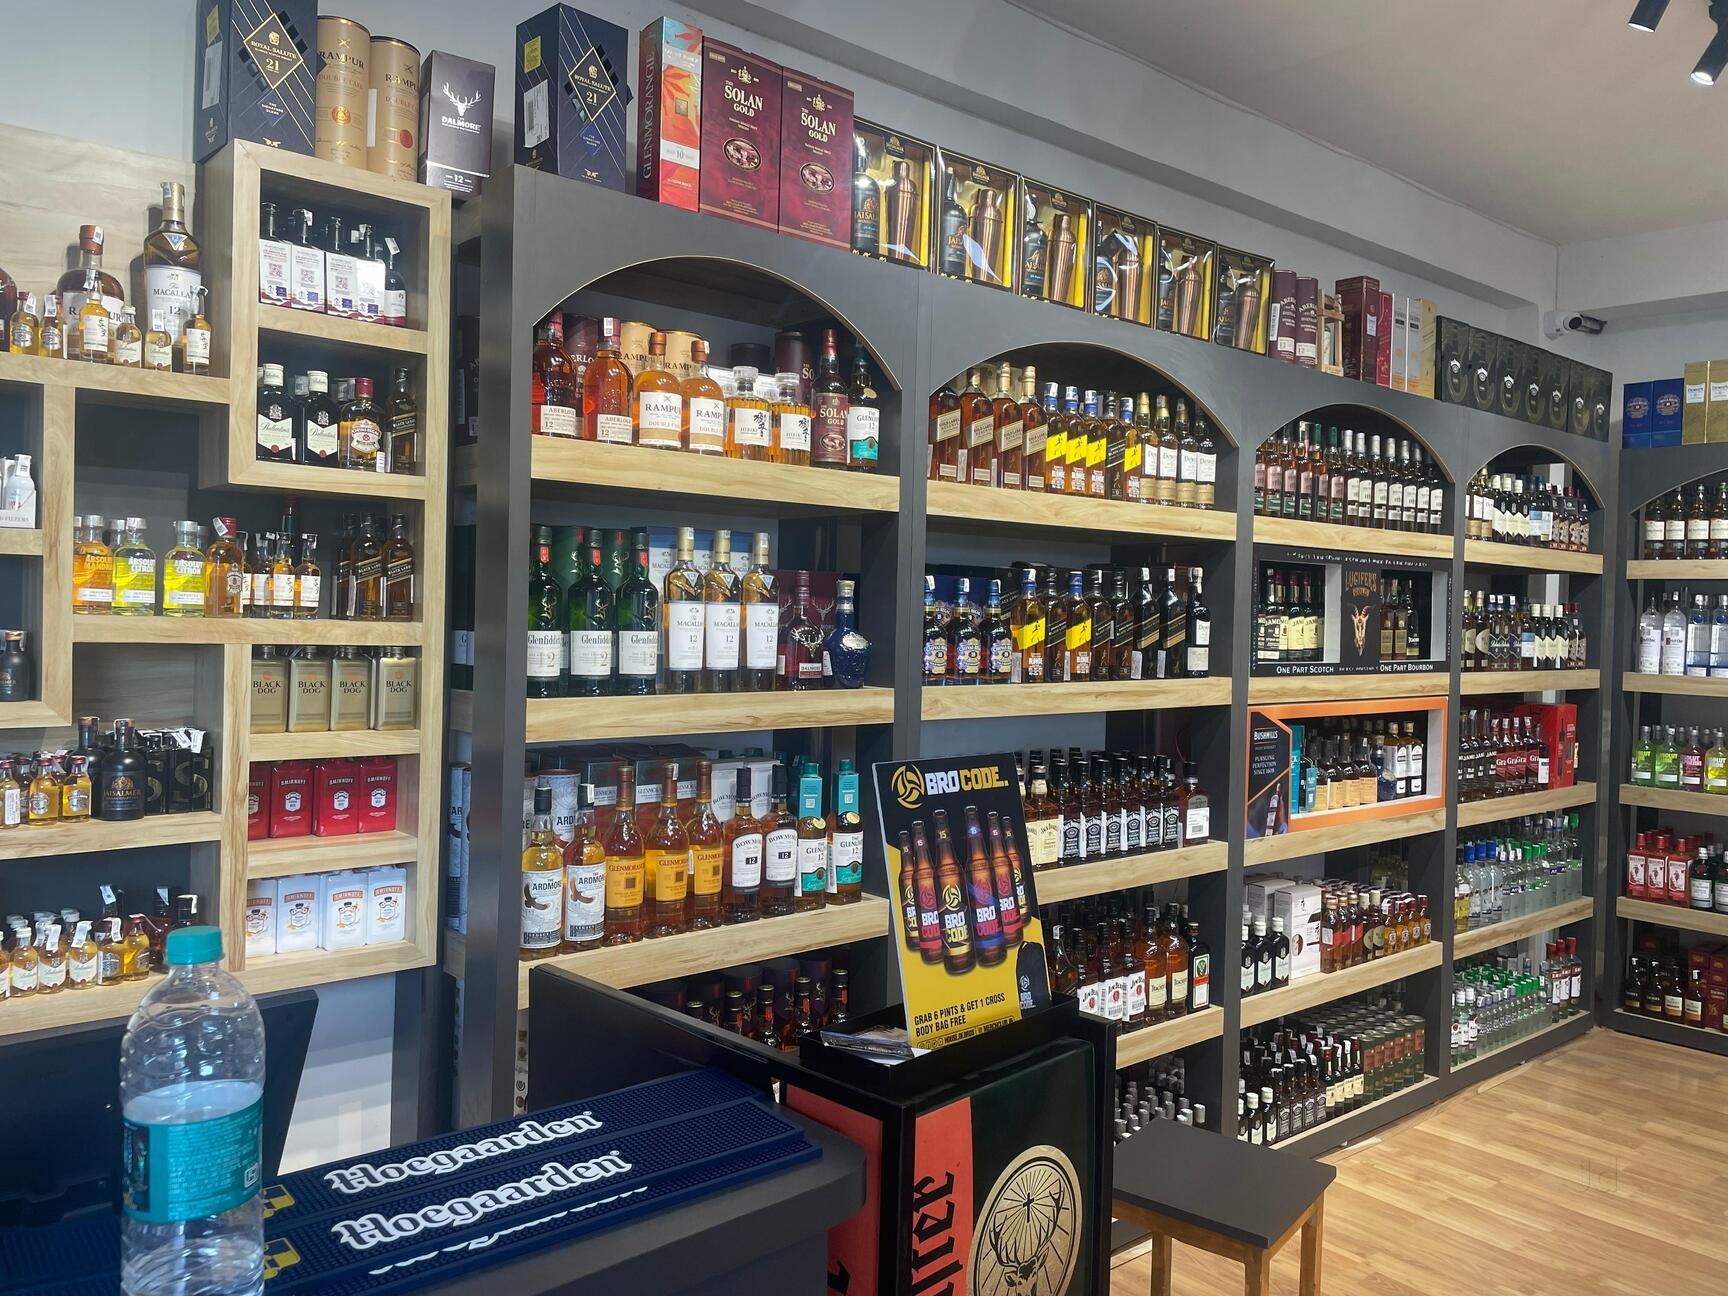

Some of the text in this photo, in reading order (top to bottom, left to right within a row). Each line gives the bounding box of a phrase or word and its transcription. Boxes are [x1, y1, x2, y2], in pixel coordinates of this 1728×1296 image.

[251, 40, 272, 51] ROYAL
[272, 47, 297, 59] SALUTE
[266, 58, 279, 71] 21
[318, 51, 365, 69] RAMPUR
[574, 74, 612, 92] ROYAL SALUTE
[586, 91, 598, 104] 21
[724, 84, 764, 111] SOLAN
[642, 52, 657, 179] GLENMORANGIE
[734, 103, 755, 118] GOLD
[442, 116, 482, 130] DALMORE
[800, 112, 836, 136] SOLAN
[808, 129, 828, 143] GOLD
[676, 150, 684, 160] 10
[454, 174, 464, 184] 12
[168, 306, 181, 316] 12
[827, 418, 845, 426] GOLD
[868, 422, 876, 430] 12
[174, 559, 203, 568] ABSOLUT
[176, 566, 200, 574] CITRON
[689, 635, 698, 643] 12
[726, 634, 734, 643] 12
[766, 634, 774, 643] 12
[1276, 666, 1290, 674] ONE
[1292, 666, 1308, 674] PART
[1309, 665, 1334, 674] SCOTCH
[1380, 664, 1392, 672] ONE
[1392, 664, 1406, 672] PART
[1407, 664, 1434, 672] BOURBON
[253, 680, 281, 688] BLACK
[298, 680, 326, 688] BLACK
[339, 680, 366, 688] BLACK
[386, 680, 412, 688] BLACK
[1254, 730, 1278, 740] BUSHMILLS
[280, 778, 306, 786] SMIRNOFF
[329, 777, 354, 785] SMIRNOFF
[103, 789, 141, 798] JAISALMER
[940, 830, 947, 838] 15
[375, 886, 402, 896] SMIRNOFF
[333, 892, 362, 901] SMIRNOFF
[922, 910, 939, 926] BRO
[976, 906, 996, 922] BRO
[944, 912, 965, 928] BRO
[976, 919, 1000, 936] CODE
[946, 925, 968, 942] CODE
[914, 992, 1006, 1026] GRAB 6 PINTS & GET 1 CROSS
[916, 1024, 934, 1038] BODY
[936, 1020, 949, 1032] BAG
[950, 1014, 966, 1028] FREE
[324, 1110, 603, 1195] Hoegaarden
[331, 1150, 633, 1252] Hoegaarden
